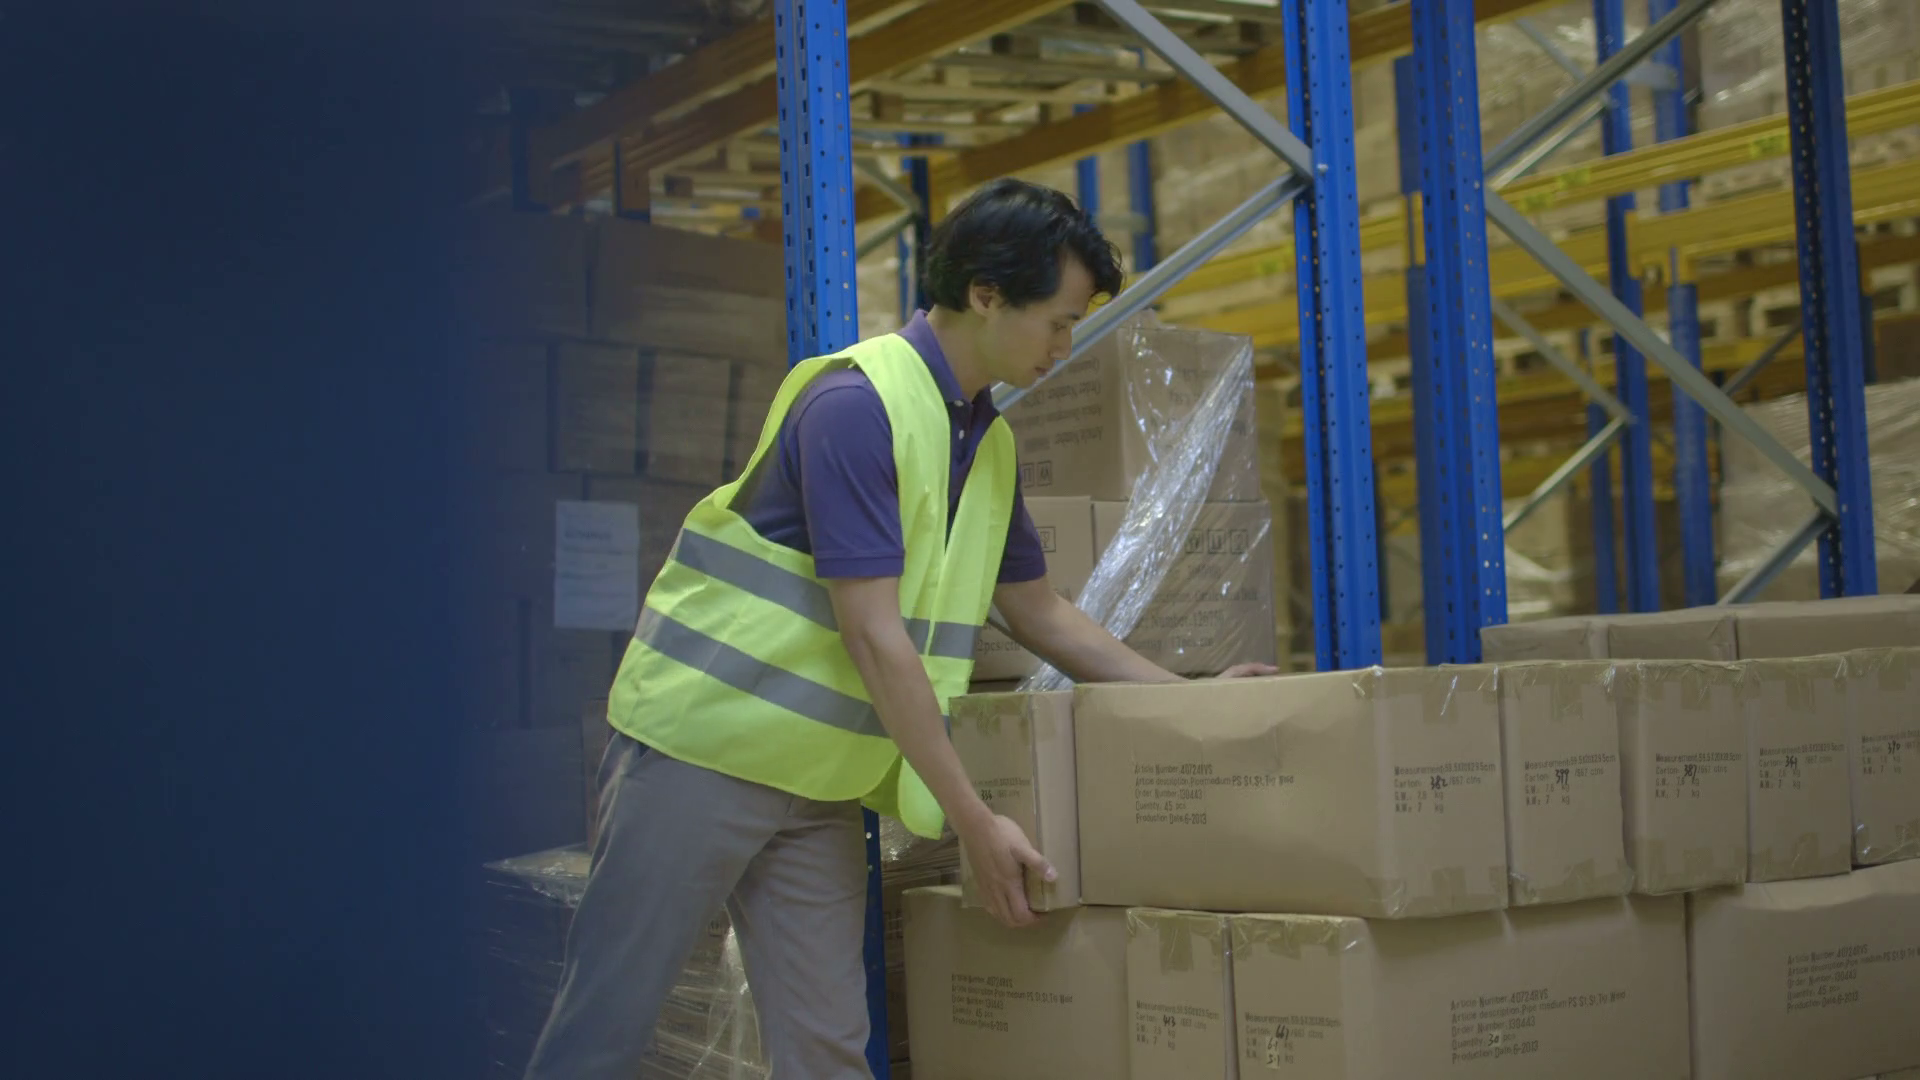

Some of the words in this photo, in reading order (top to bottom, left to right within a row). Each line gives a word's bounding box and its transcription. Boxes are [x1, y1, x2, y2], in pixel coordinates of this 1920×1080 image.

[1555, 768, 1569, 785] 399
[1684, 764, 1697, 784] 387
[1430, 775, 1448, 790] 382
[1135, 789, 1152, 799] Order
[1451, 999, 1477, 1010] Article
[1451, 1012, 1477, 1024] Article
[1539, 1000, 1567, 1011] medium
[1568, 997, 1577, 1009] PS
[1452, 1025, 1473, 1037] Order
[1488, 1033, 1499, 1046] 30
[1452, 1050, 1493, 1064] Production
